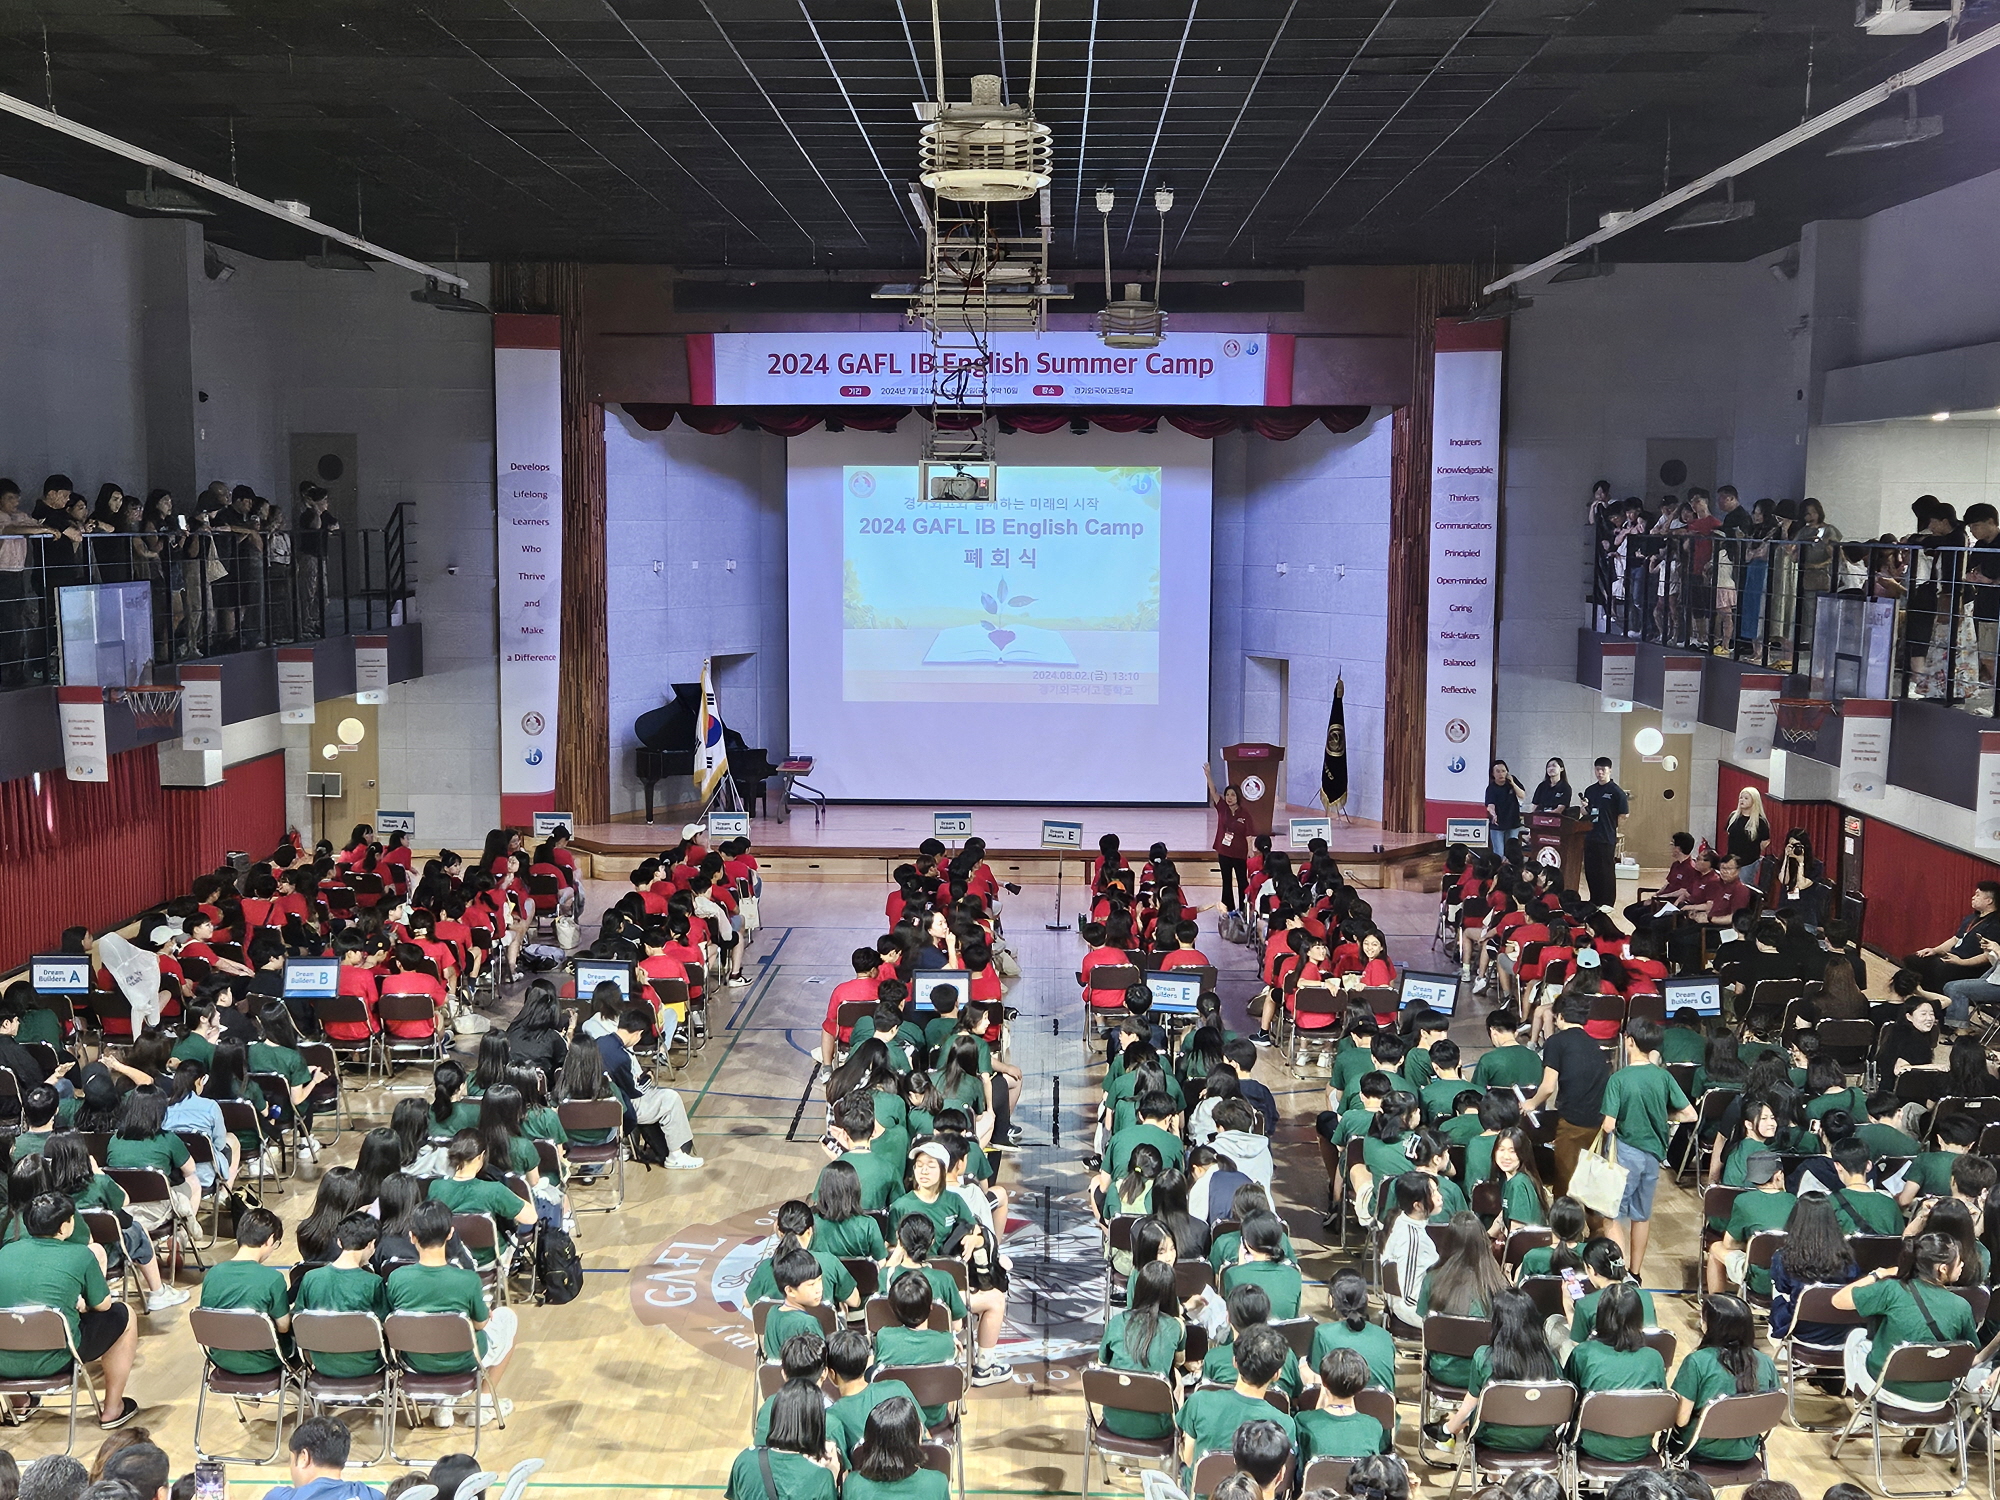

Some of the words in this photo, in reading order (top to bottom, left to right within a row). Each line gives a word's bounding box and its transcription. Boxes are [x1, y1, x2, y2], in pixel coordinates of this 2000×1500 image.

[767, 352, 830, 374] 2024
[837, 352, 903, 374] GAFL
[910, 352, 935, 374] IB
[943, 351, 1029, 378] English
[1036, 352, 1139, 374] Summer
[1145, 352, 1215, 379] Camp
[880, 387, 906, 396] 2024년
[1449, 438, 1482, 448] Inquirers
[510, 462, 550, 473] Develops
[1437, 465, 1494, 476] Knowledgeable
[513, 489, 549, 501] Lifelong
[1449, 493, 1480, 502] Thinkers
[1030, 497, 1068, 511] 미래의
[1073, 497, 1100, 511] 시작
[512, 517, 550, 527] Learners
[1435, 521, 1492, 530] Communicators
[859, 517, 907, 535] 2024
[912, 517, 970, 535] GAFL
[975, 518, 996, 535] IB
[1002, 518, 1078, 540] English
[1084, 518, 1144, 540] Camp
[521, 544, 542, 554] Who
[1444, 549, 1481, 559] Principled
[964, 548, 983, 569] 폐
[990, 548, 1010, 569] 회
[1018, 548, 1038, 570] 식
[518, 572, 546, 581] Thrive
[1436, 576, 1487, 586] Open-minded
[523, 599, 541, 609] and
[1449, 604, 1473, 614] Caring
[521, 626, 545, 636] Make
[1440, 631, 1480, 640] Risk-takers
[514, 653, 557, 662] Difference
[1443, 659, 1476, 667] Balanced
[1032, 669, 1108, 682] 2024.08.02.(금)
[1112, 670, 1140, 682] 13:10
[1039, 683, 1134, 697] 경기외국어고등학교
[1441, 686, 1477, 695] Reflective
[401, 819, 409, 830] A
[734, 821, 742, 832] C
[958, 821, 966, 831] D
[1068, 831, 1075, 841] E
[1317, 828, 1323, 838] F
[1472, 828, 1481, 839] G
[69, 969, 81, 984] A
[319, 971, 329, 985] B
[1155, 984, 1176, 992] Dream
[1412, 985, 1433, 993] Dream
[1181, 987, 1191, 1001] E
[1406, 990, 1433, 1000] Builders
[1437, 988, 1447, 1002] F
[1700, 990, 1712, 1005] G
[1671, 997, 1699, 1005] Builders
[644, 1237, 728, 1308] GAFL
